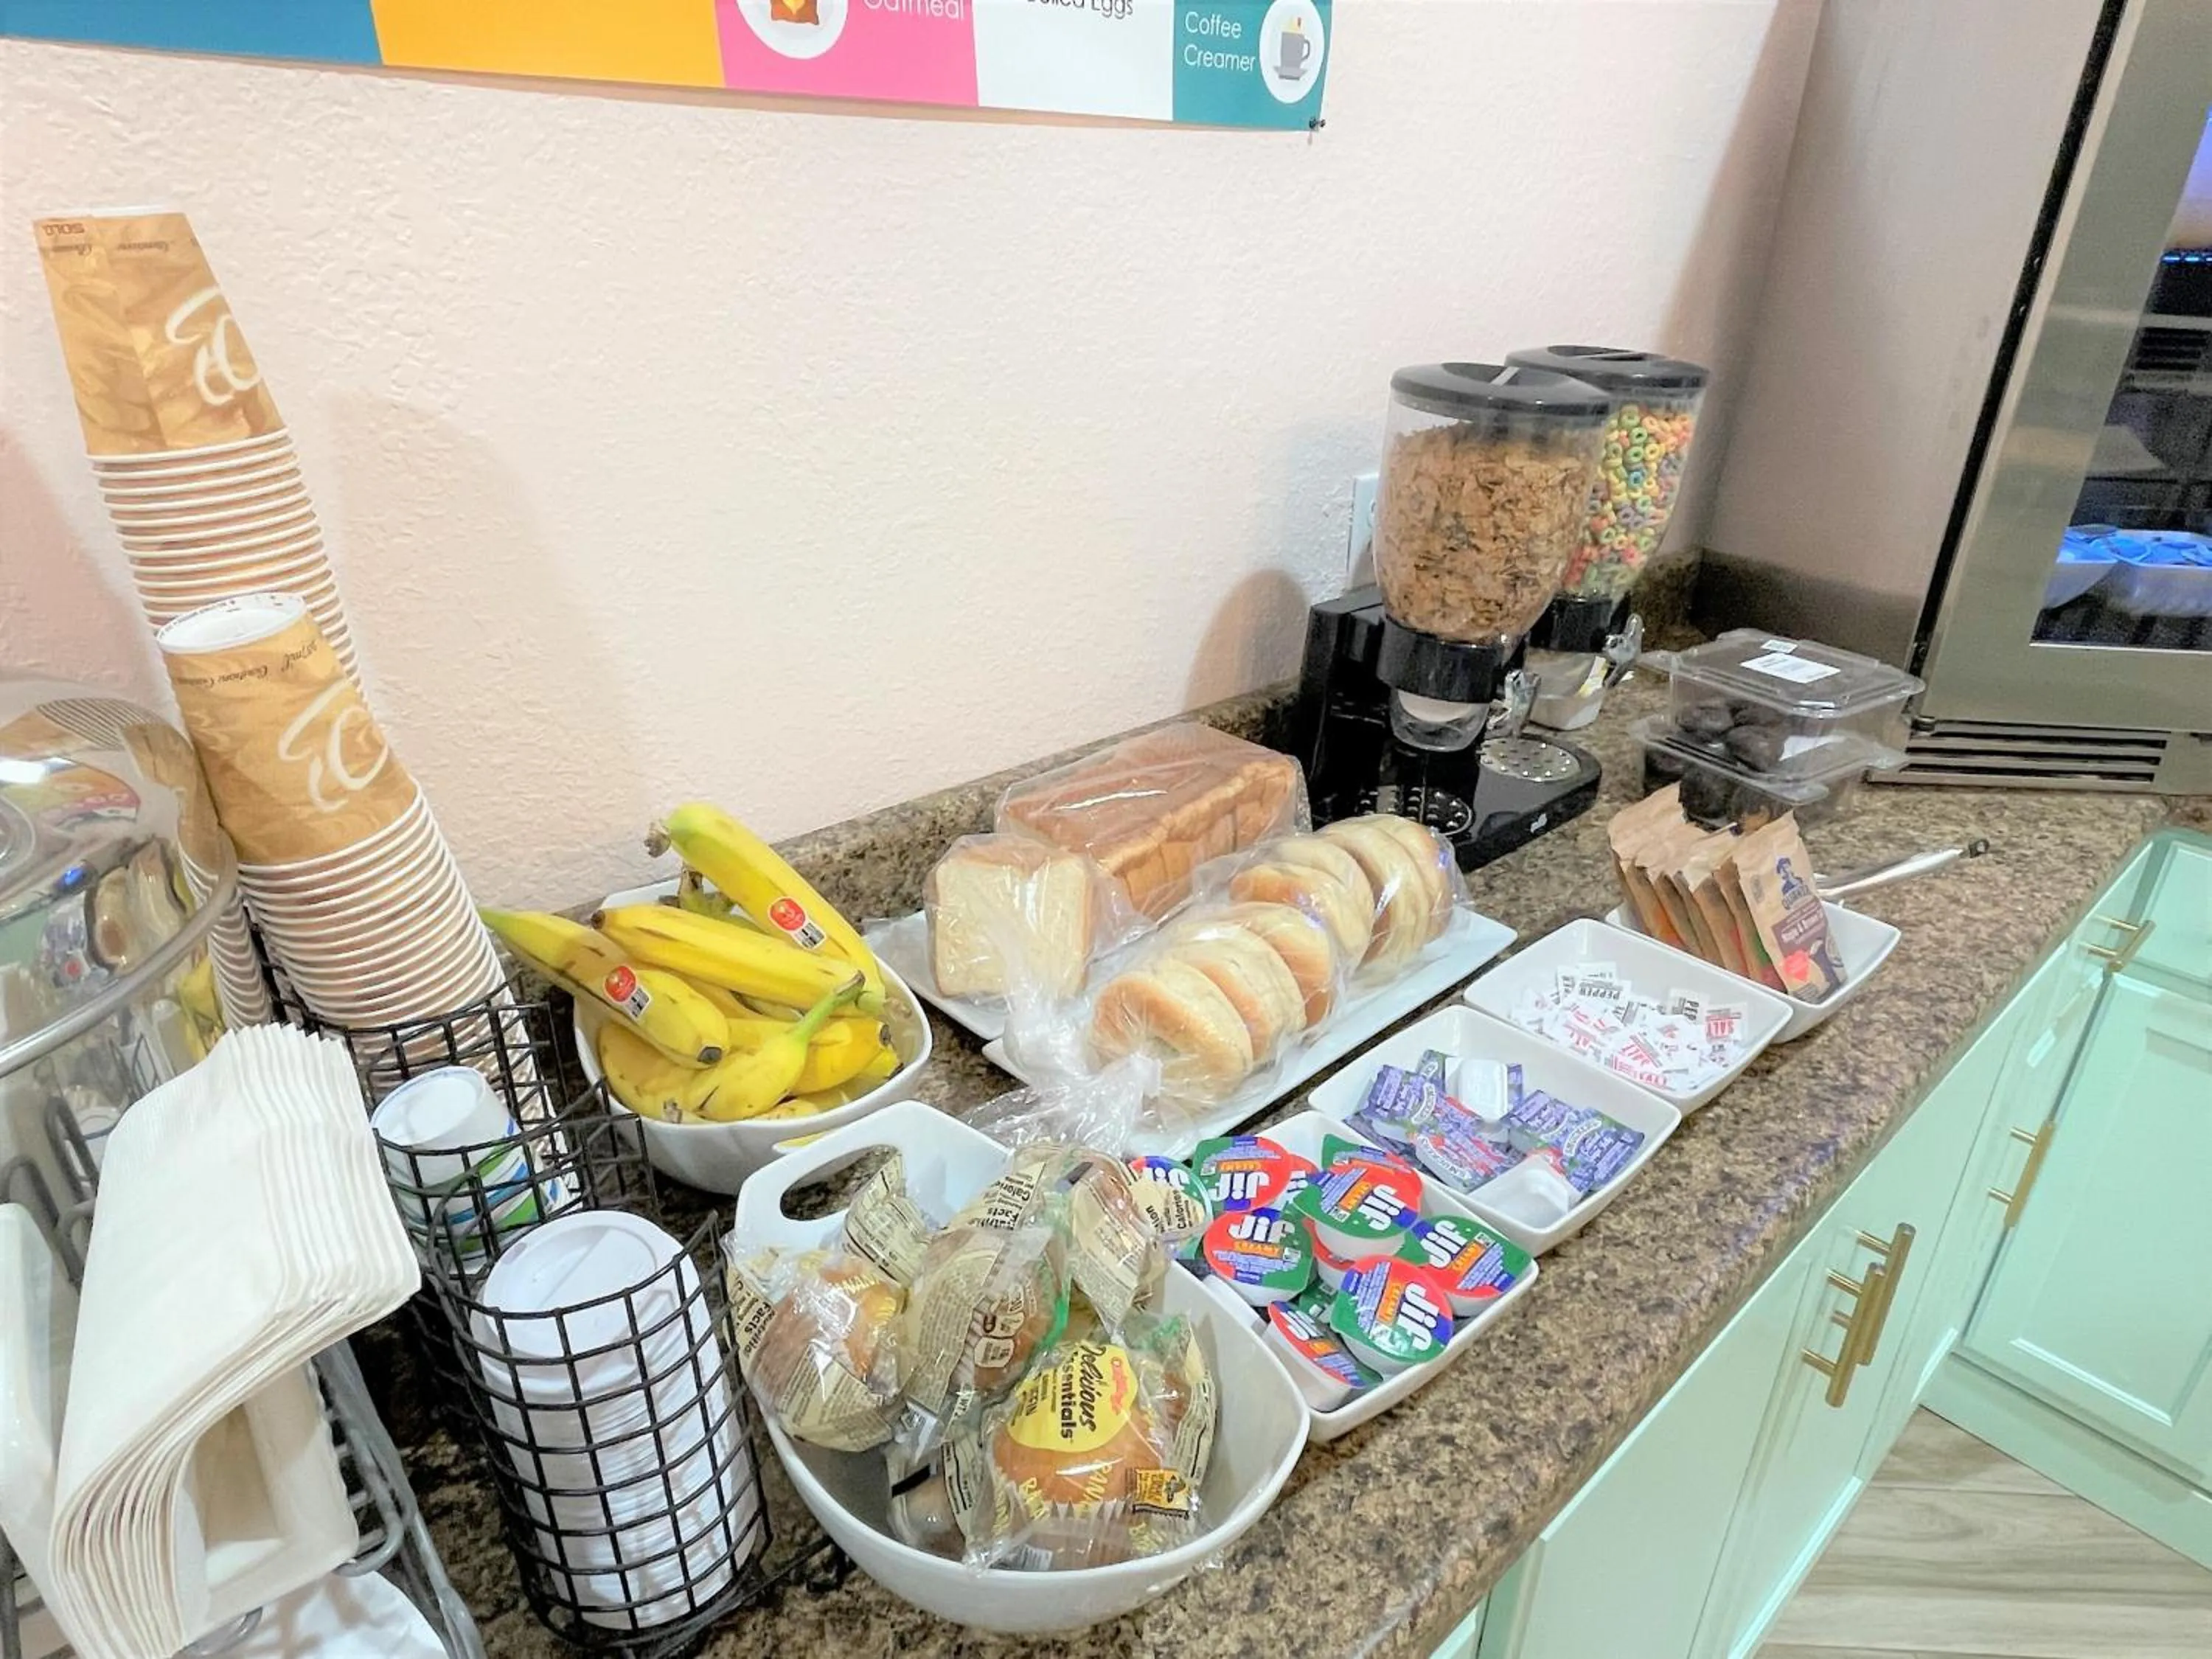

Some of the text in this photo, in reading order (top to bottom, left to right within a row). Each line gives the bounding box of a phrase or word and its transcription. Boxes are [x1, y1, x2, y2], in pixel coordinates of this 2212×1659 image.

[1185, 11, 1242, 38] Coffee
[1184, 44, 1256, 72] Creamer
[1208, 1171, 1270, 1202] Jif
[1357, 1183, 1406, 1231] Jif
[1228, 1214, 1295, 1243] Jif
[1420, 1220, 1468, 1269] Jif
[744, 1301, 773, 1333] Facts
[1397, 1282, 1440, 1351] Jif
[1079, 1343, 1107, 1433] Delicious
